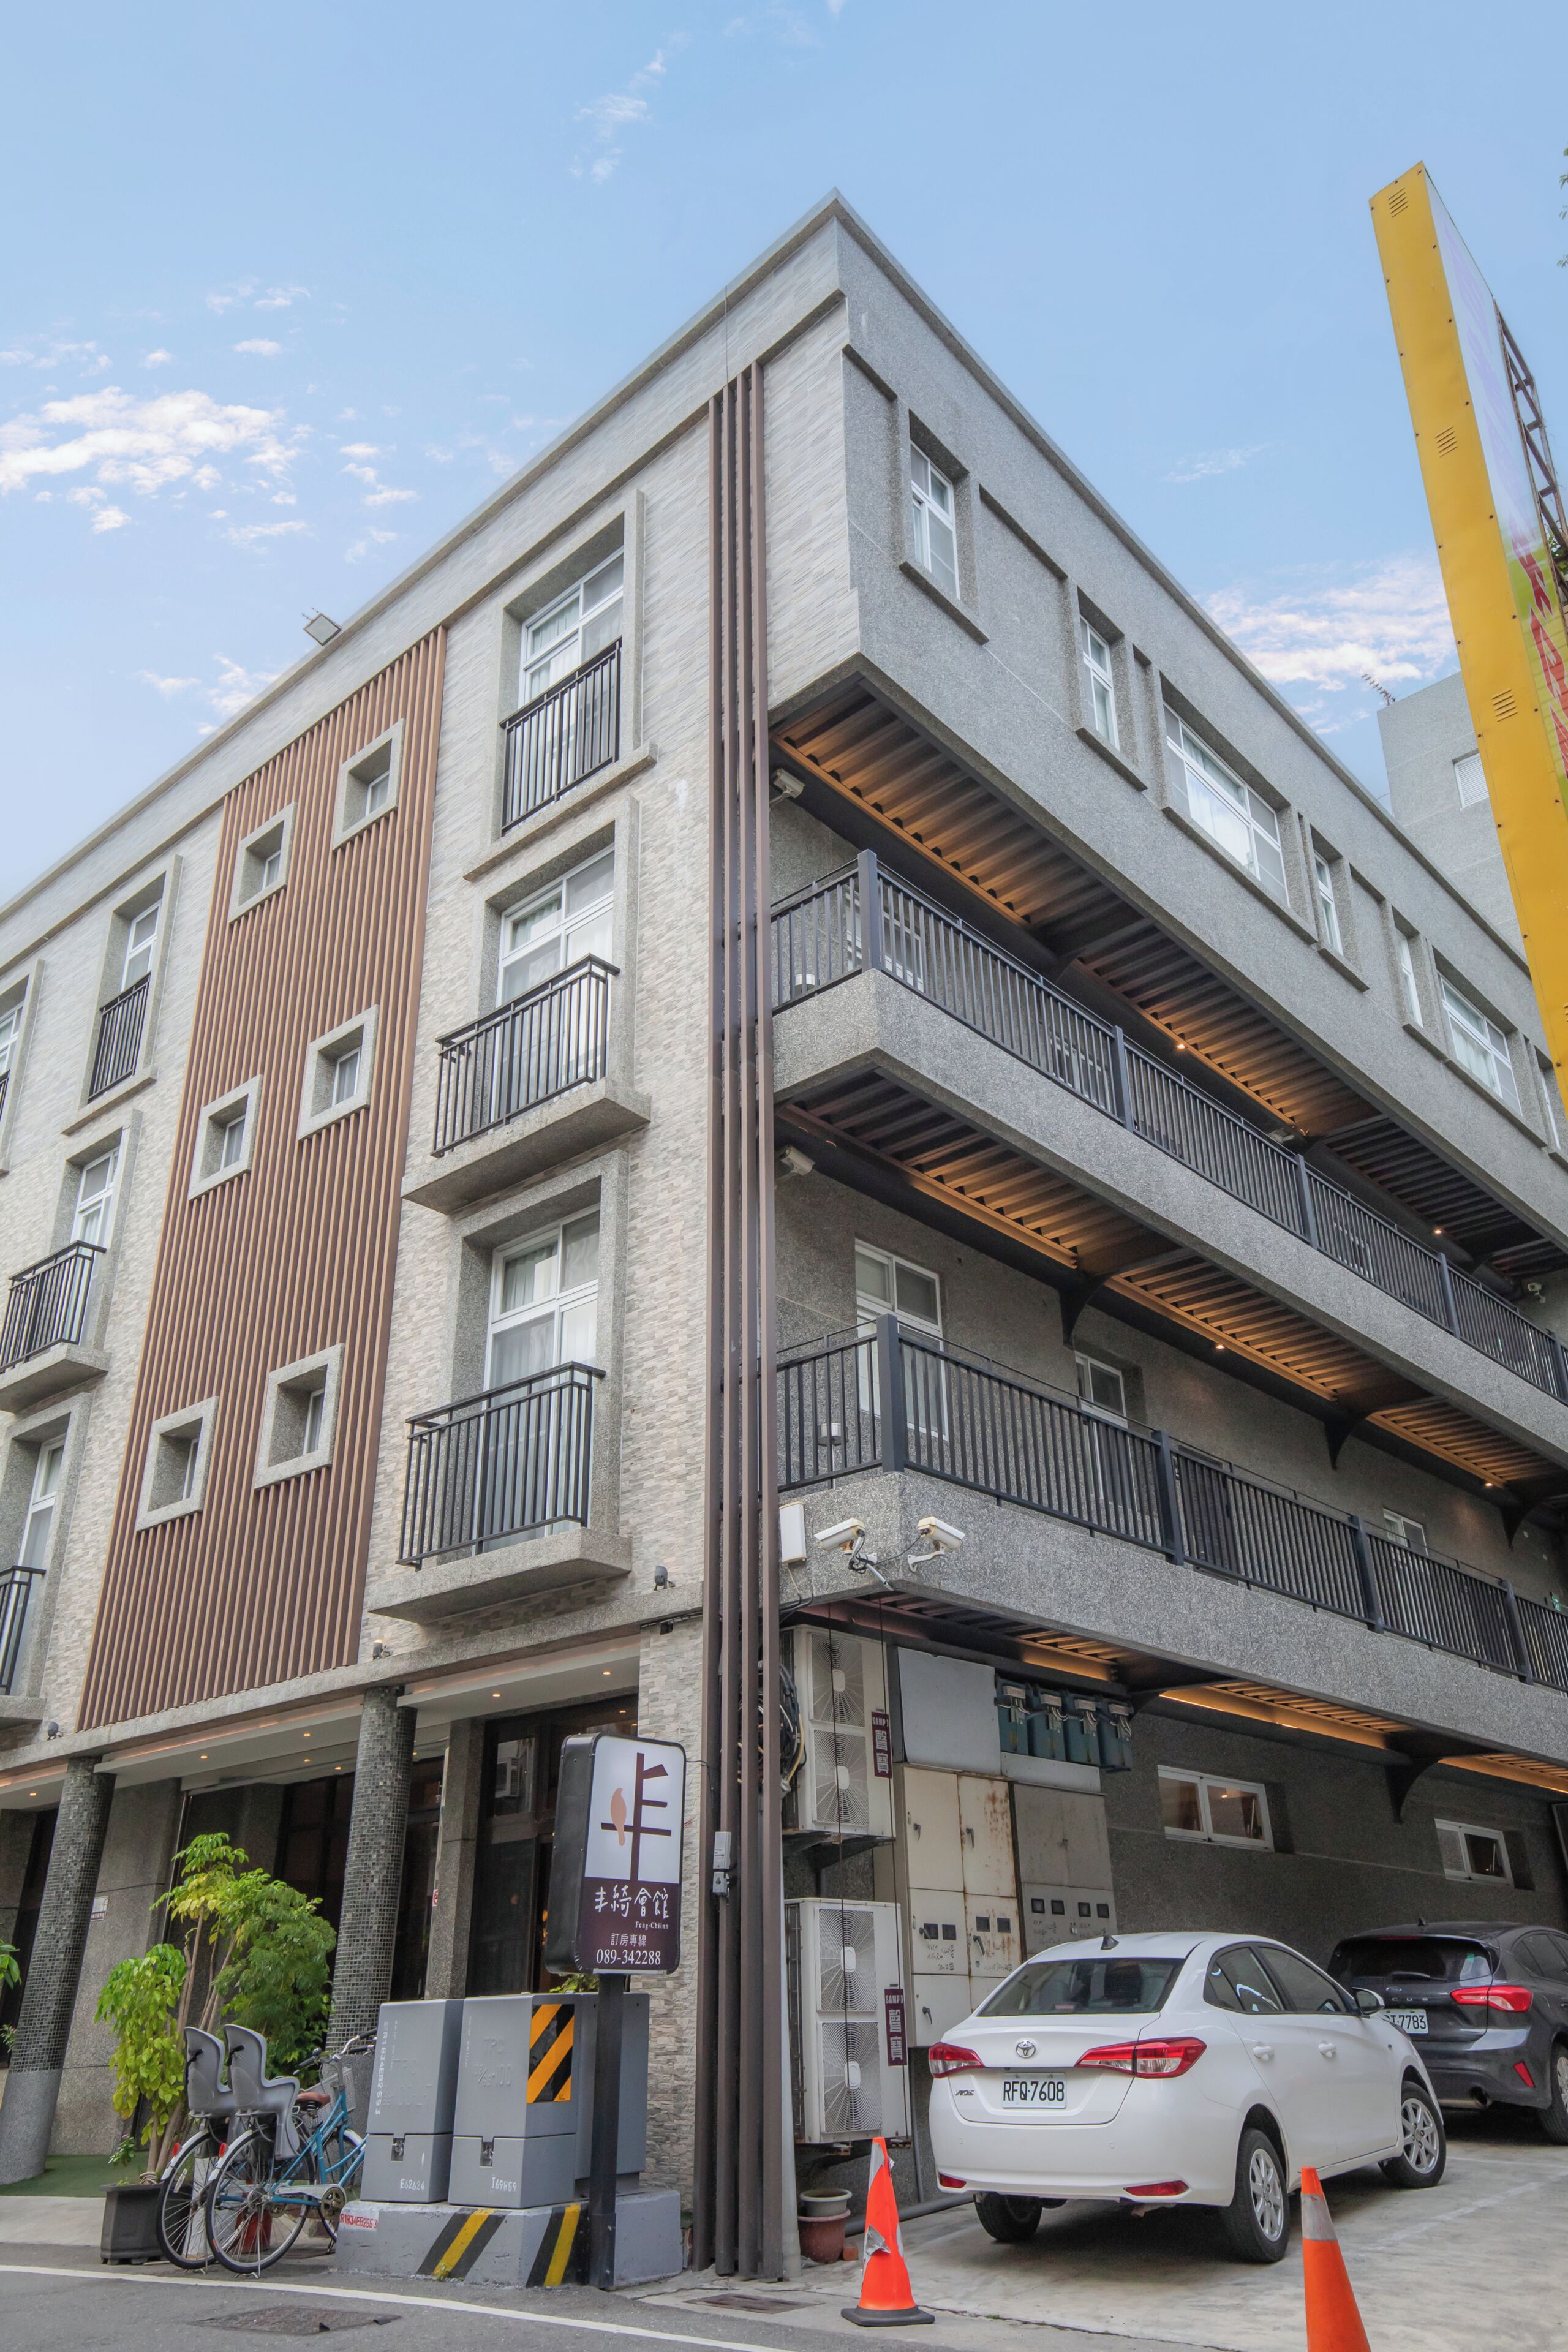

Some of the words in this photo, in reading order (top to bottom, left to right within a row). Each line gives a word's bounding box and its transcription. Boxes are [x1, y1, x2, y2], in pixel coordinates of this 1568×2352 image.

[635, 1921, 669, 1930] Feng-Chiinn
[611, 1933, 647, 1947] 訂房專線
[597, 1948, 661, 1965] 089-342288
